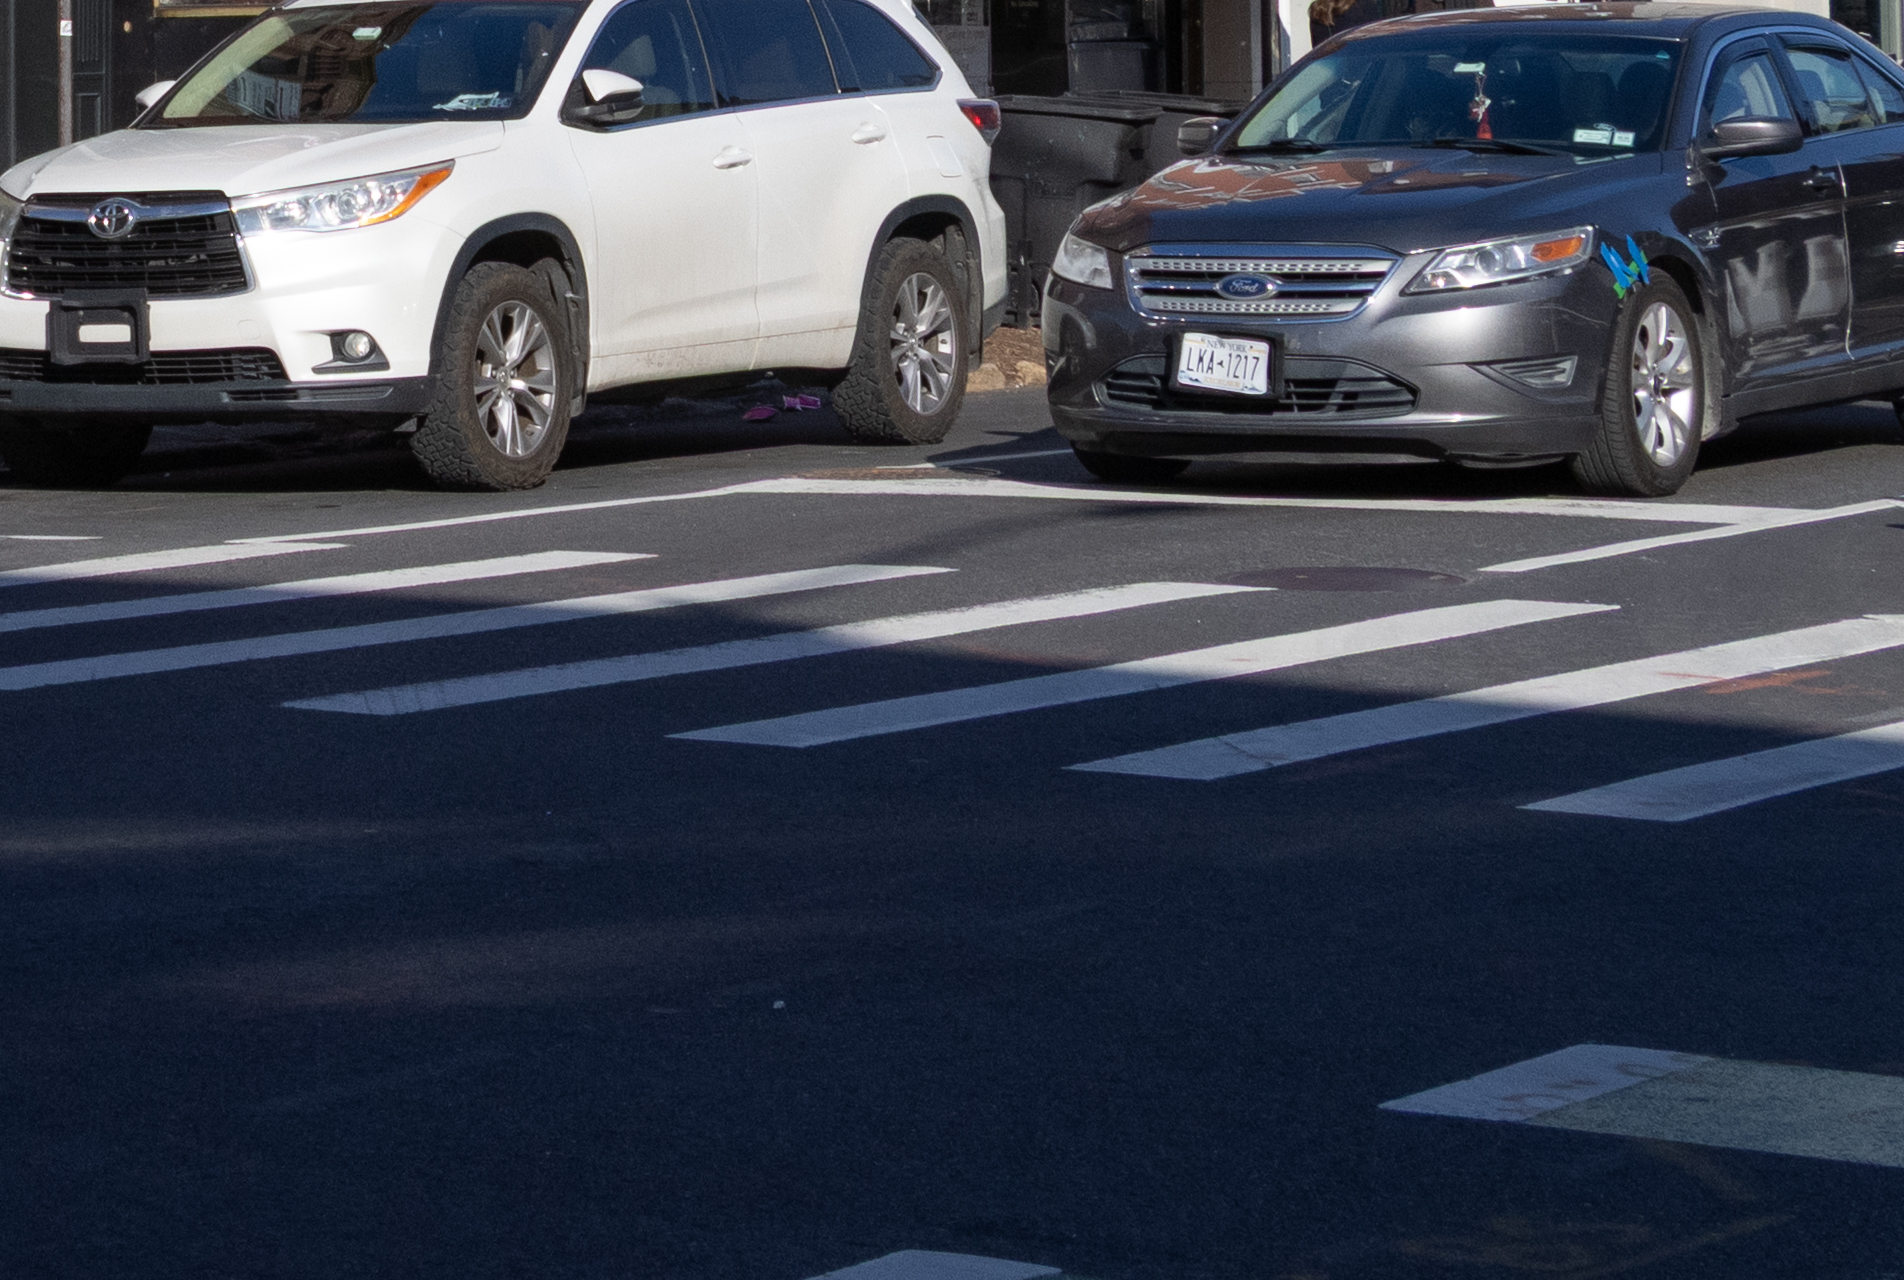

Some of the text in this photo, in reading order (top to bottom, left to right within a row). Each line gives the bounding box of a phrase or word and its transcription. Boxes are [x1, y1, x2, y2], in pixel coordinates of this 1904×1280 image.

[1229, 279, 1259, 294] Ford
[1206, 339, 1249, 353] NEW YORK
